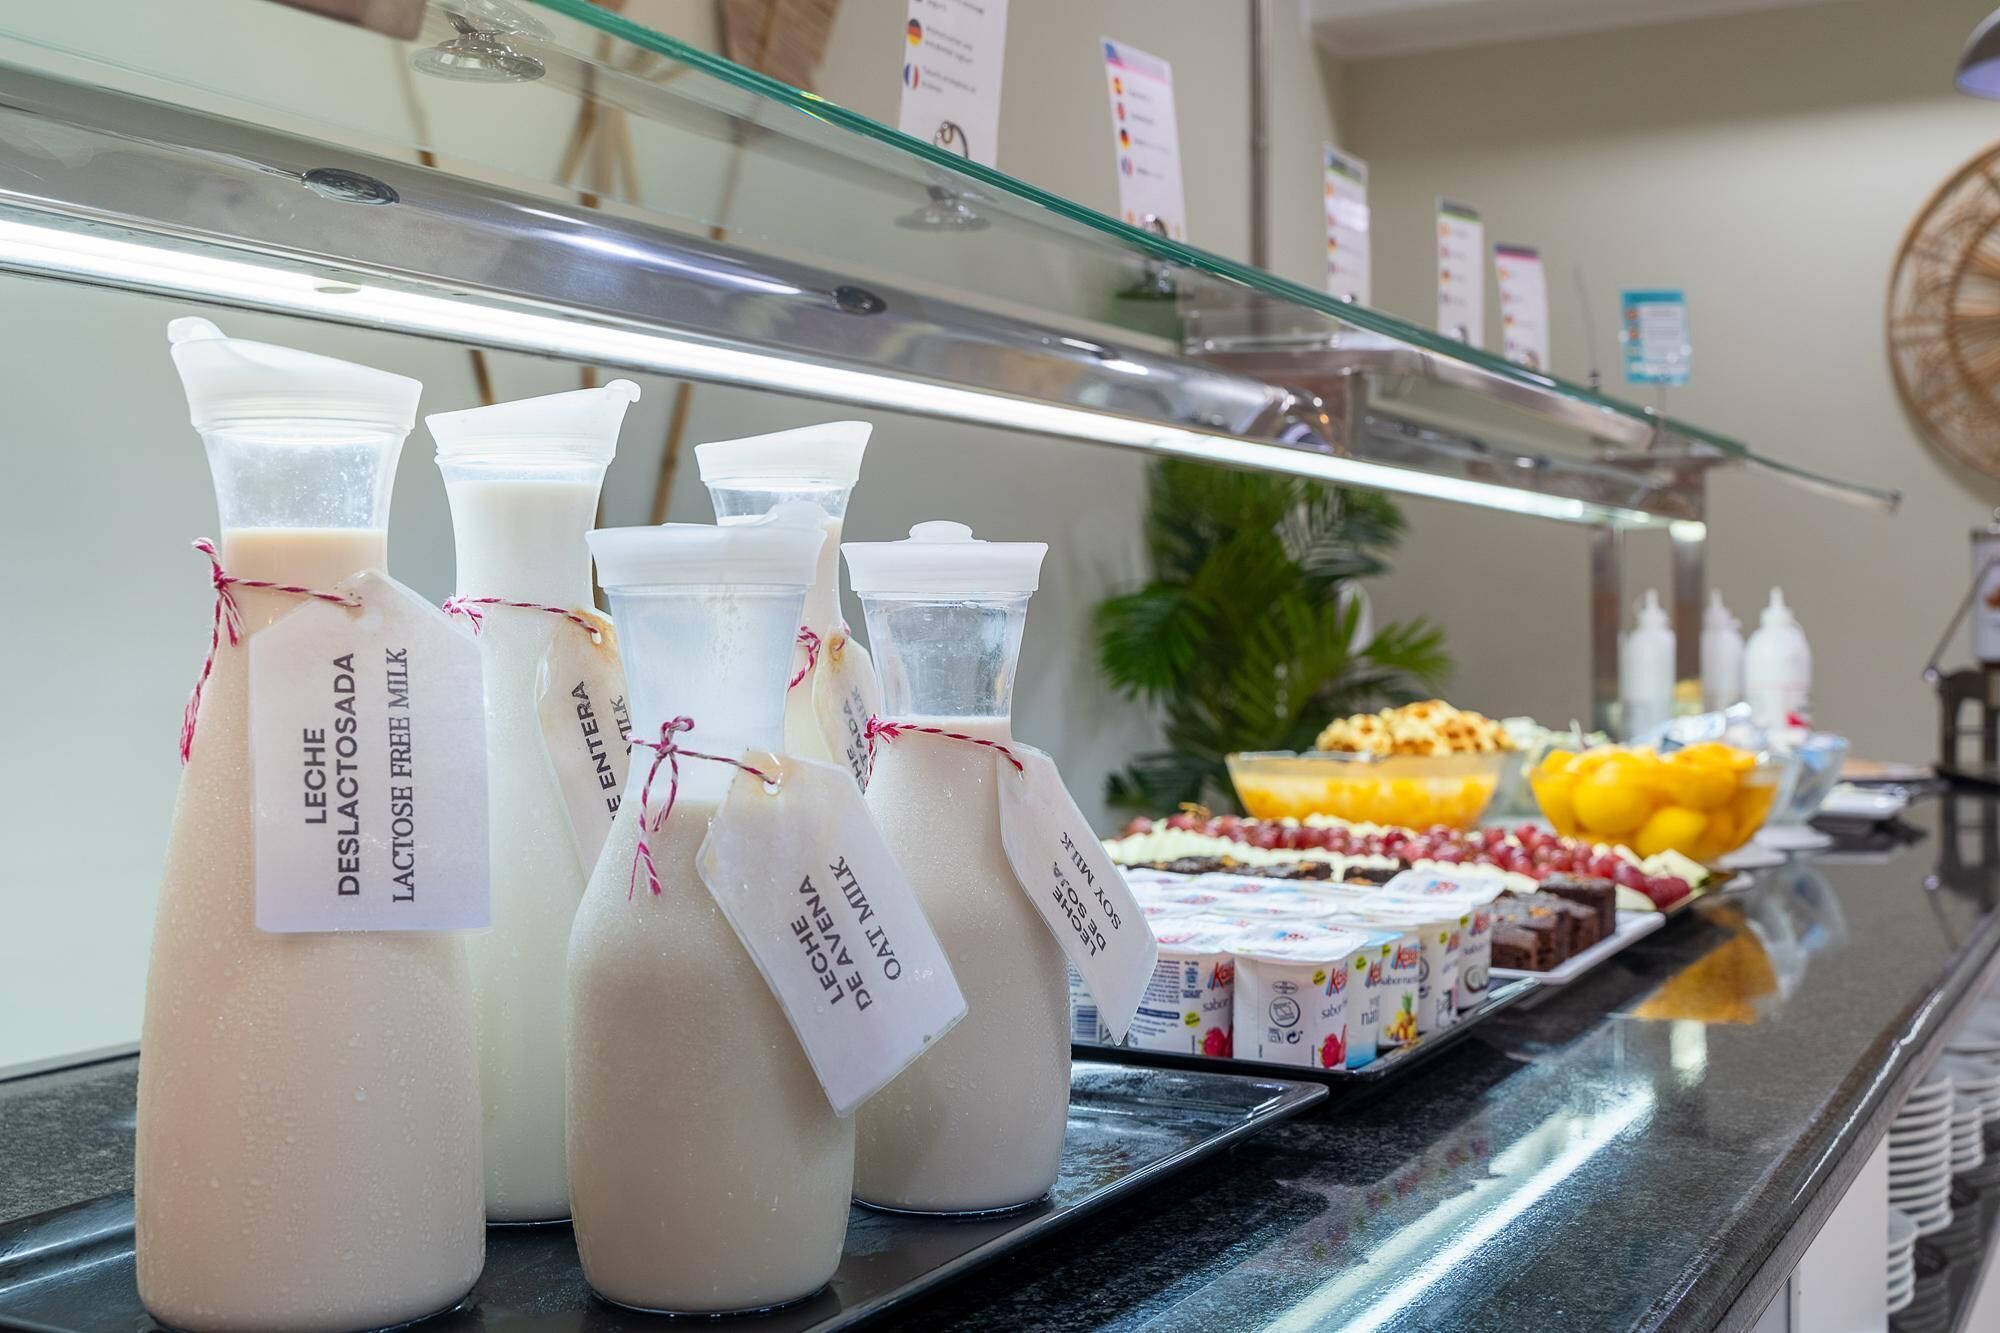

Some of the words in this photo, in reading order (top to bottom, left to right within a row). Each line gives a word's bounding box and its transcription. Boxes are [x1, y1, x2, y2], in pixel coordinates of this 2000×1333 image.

[385, 647, 411, 710] MILK
[388, 716, 413, 780] FREE
[571, 680, 617, 790] ENTERA
[303, 727, 328, 825] LECHE
[332, 652, 361, 897] DESLACTOSADA
[846, 744, 866, 796] CHE
[391, 786, 415, 904] LACTOSE
[1058, 831, 1096, 888] MILK
[798, 874, 854, 966] AVENA
[828, 855, 876, 924] MILK
[1051, 884, 1098, 957] LECHE
[1094, 885, 1122, 930] SOY
[790, 913, 846, 1005] LECHE
[865, 925, 903, 982] OAT
[1087, 918, 1108, 953] DE
[845, 970, 873, 1013] DE
